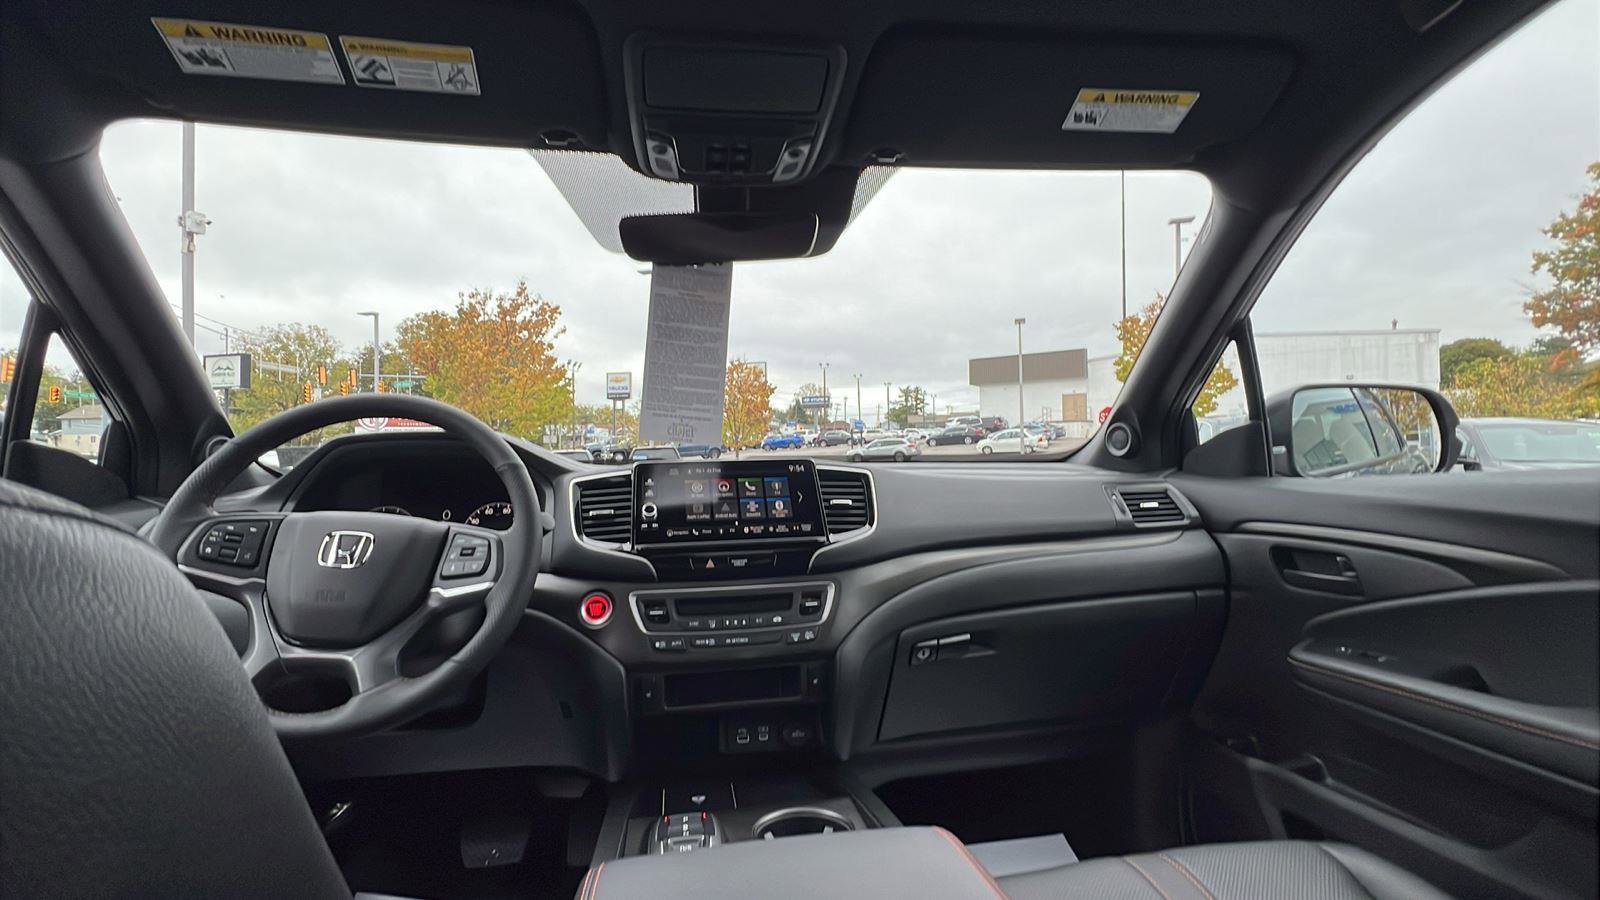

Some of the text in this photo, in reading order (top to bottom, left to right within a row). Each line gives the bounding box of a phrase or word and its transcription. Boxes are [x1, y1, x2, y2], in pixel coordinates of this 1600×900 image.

[208, 25, 307, 48] WARNING
[1114, 92, 1180, 105] WARNING
[788, 464, 805, 473] 9:54
